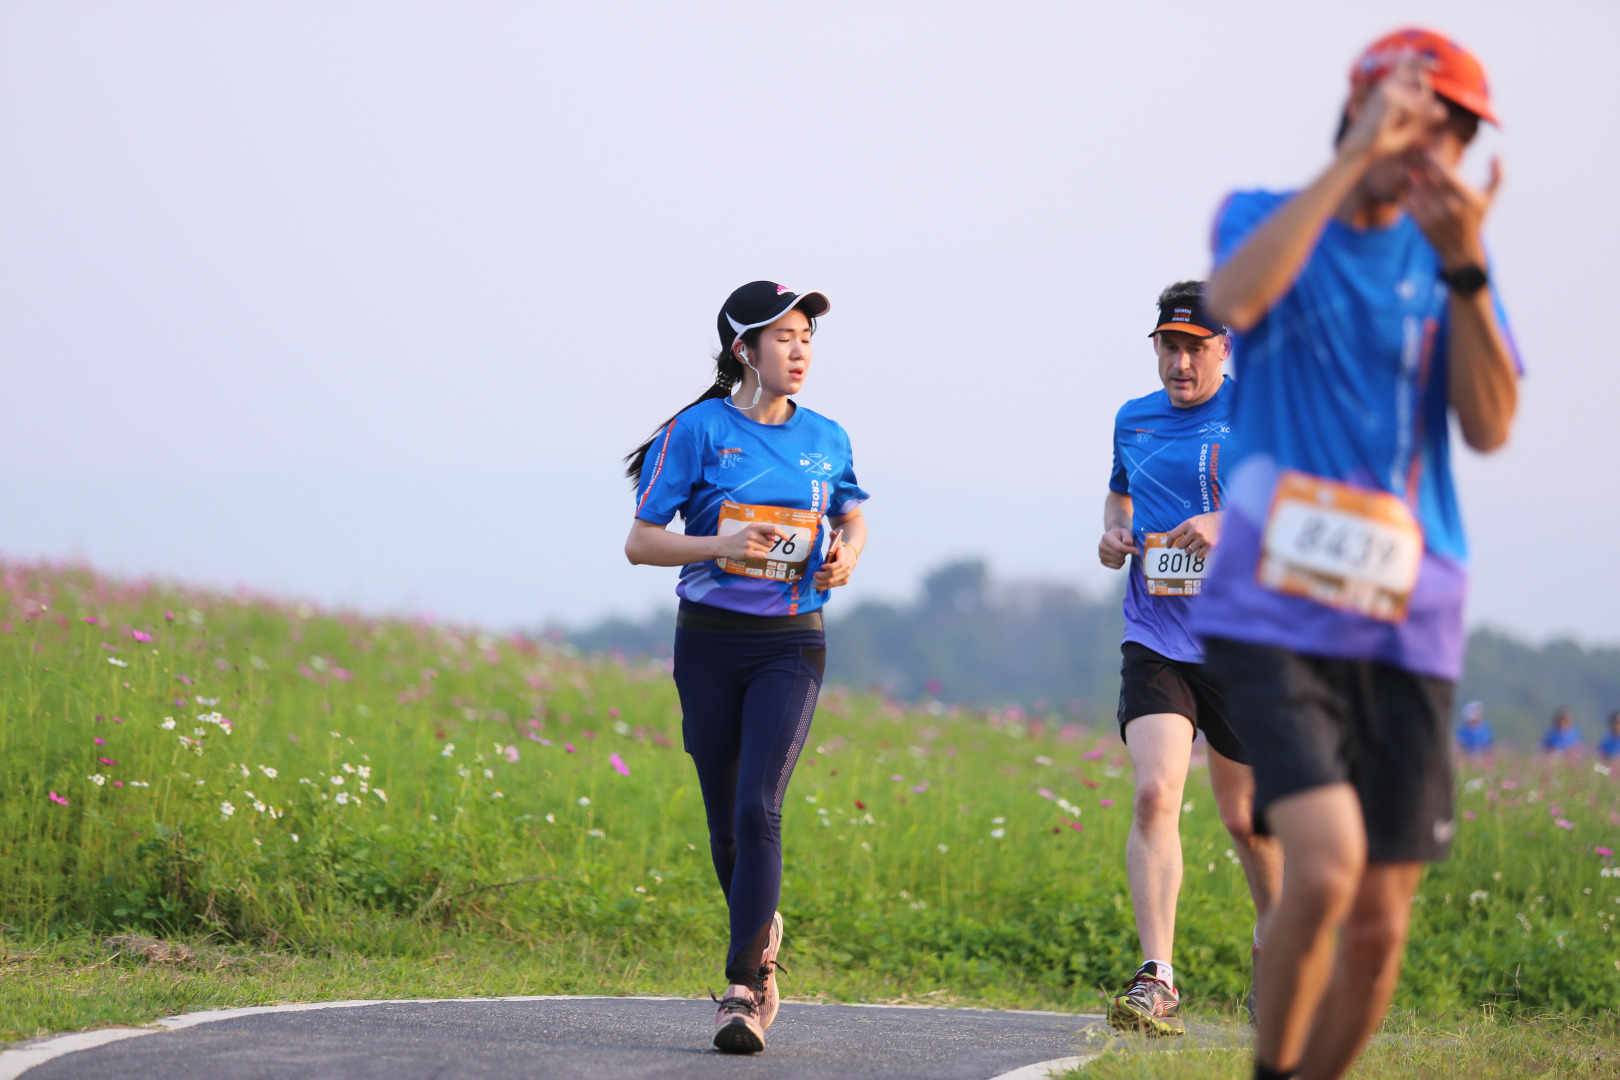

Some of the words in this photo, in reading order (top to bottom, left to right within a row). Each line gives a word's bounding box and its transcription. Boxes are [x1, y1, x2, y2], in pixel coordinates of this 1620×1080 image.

[1220, 426, 1231, 434] XC
[799, 459, 809, 467] SP
[1198, 443, 1209, 473] CROSS
[1209, 443, 1220, 482] SINGHA
[811, 479, 819, 513] CROSS
[1198, 474, 1211, 513] COUNTR
[1210, 483, 1222, 511] PARK
[1158, 553, 1206, 573] 8018
